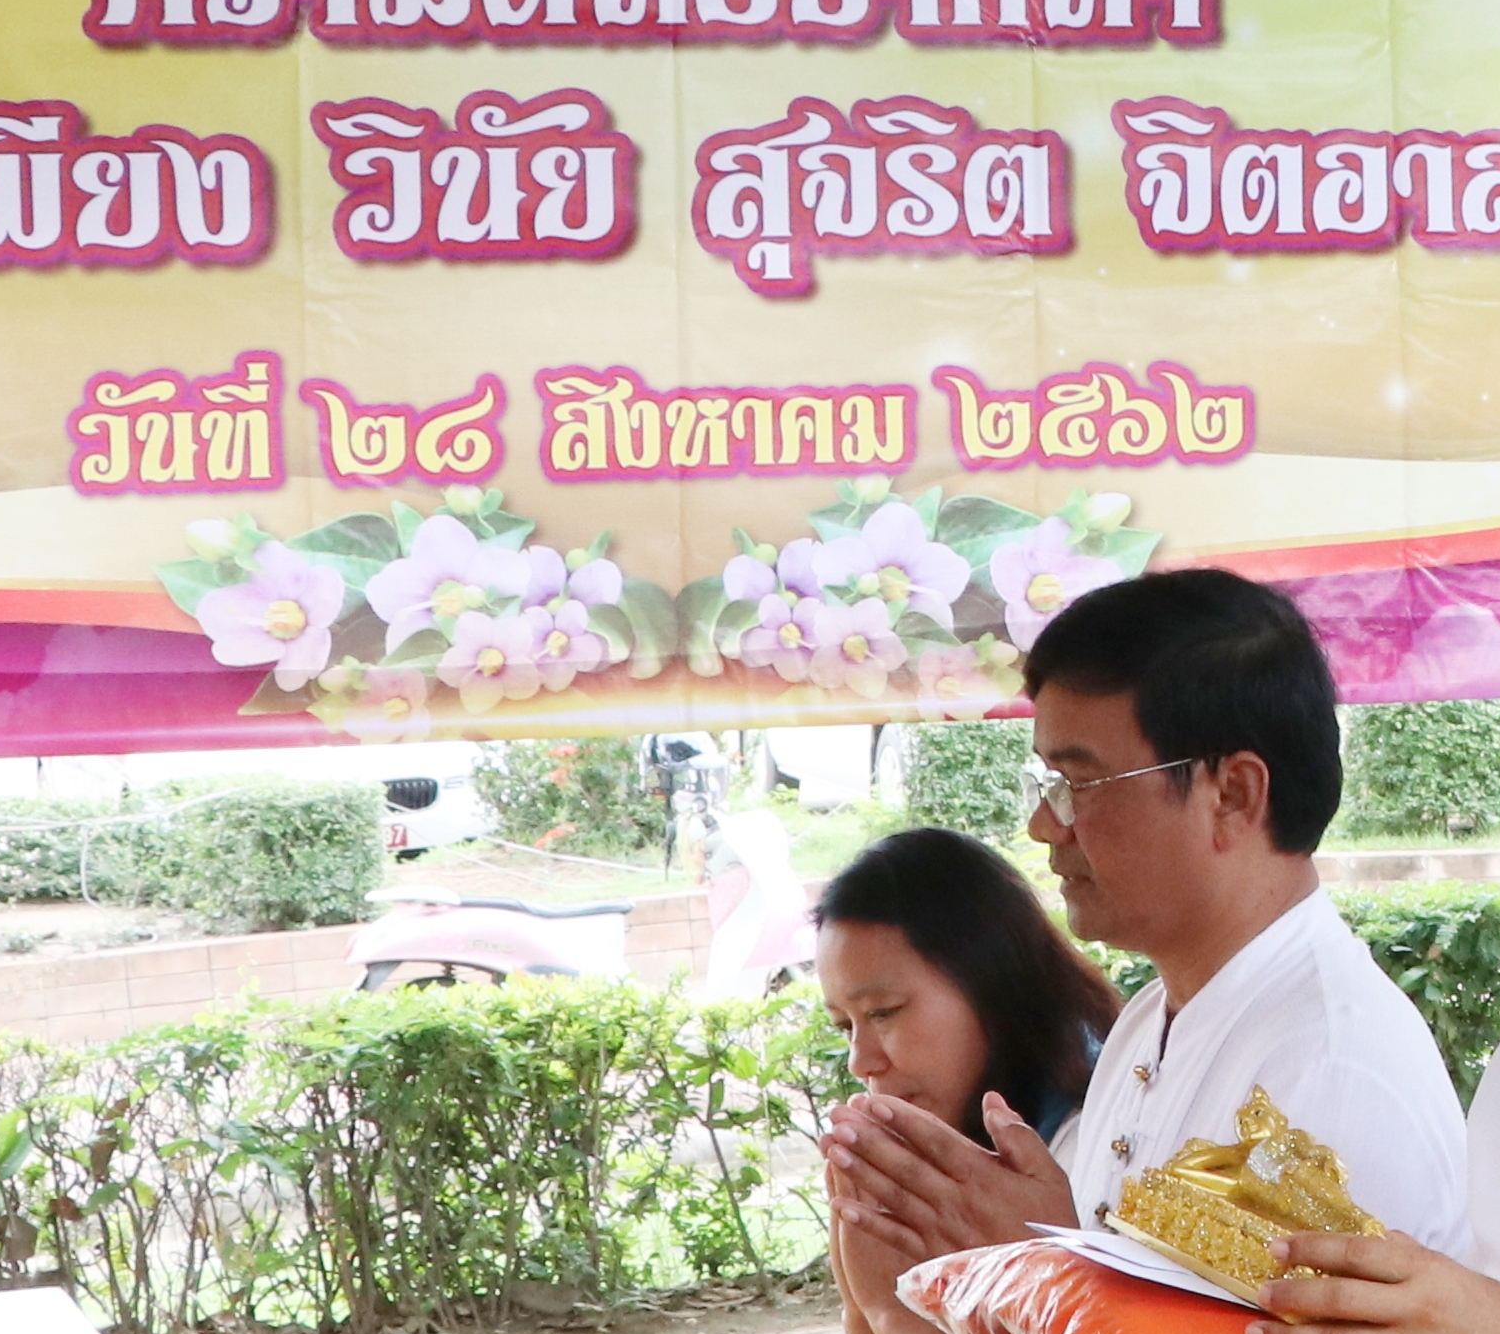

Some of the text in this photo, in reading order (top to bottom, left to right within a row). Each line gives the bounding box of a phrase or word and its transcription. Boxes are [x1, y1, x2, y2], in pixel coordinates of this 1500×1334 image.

[321, 99, 620, 247] วินัย
[703, 107, 1056, 283] สุจริต
[75, 359, 1248, 486] วันที่ ๒๘ สิงหาคม ๒๕๖๒
